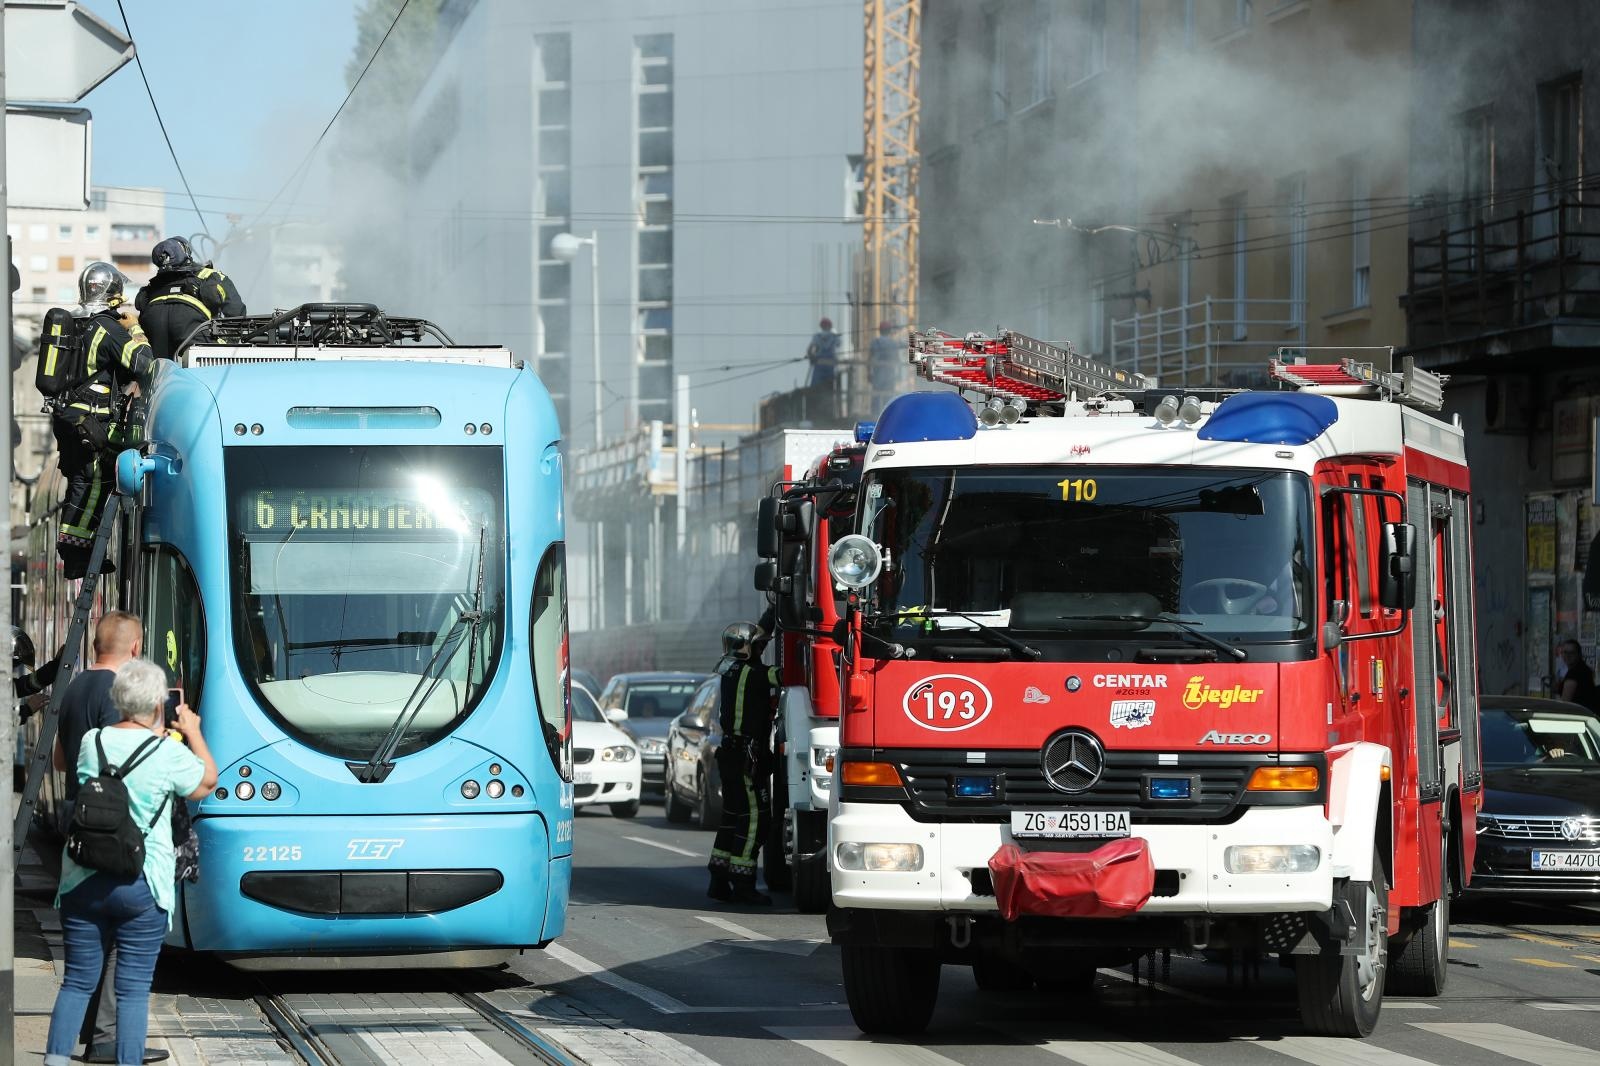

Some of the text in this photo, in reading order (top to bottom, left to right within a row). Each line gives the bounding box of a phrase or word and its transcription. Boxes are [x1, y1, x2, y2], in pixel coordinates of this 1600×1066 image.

[1057, 478, 1097, 501] 110
[256, 491, 275, 529] 6
[1093, 674, 1168, 688] CENTAR
[1183, 676, 1264, 710] Ziegler
[923, 691, 976, 720] 193
[1024, 813, 1046, 831] ZG
[243, 846, 303, 862] 22125
[347, 838, 406, 860] ZET
[1541, 854, 1556, 866] ZG
